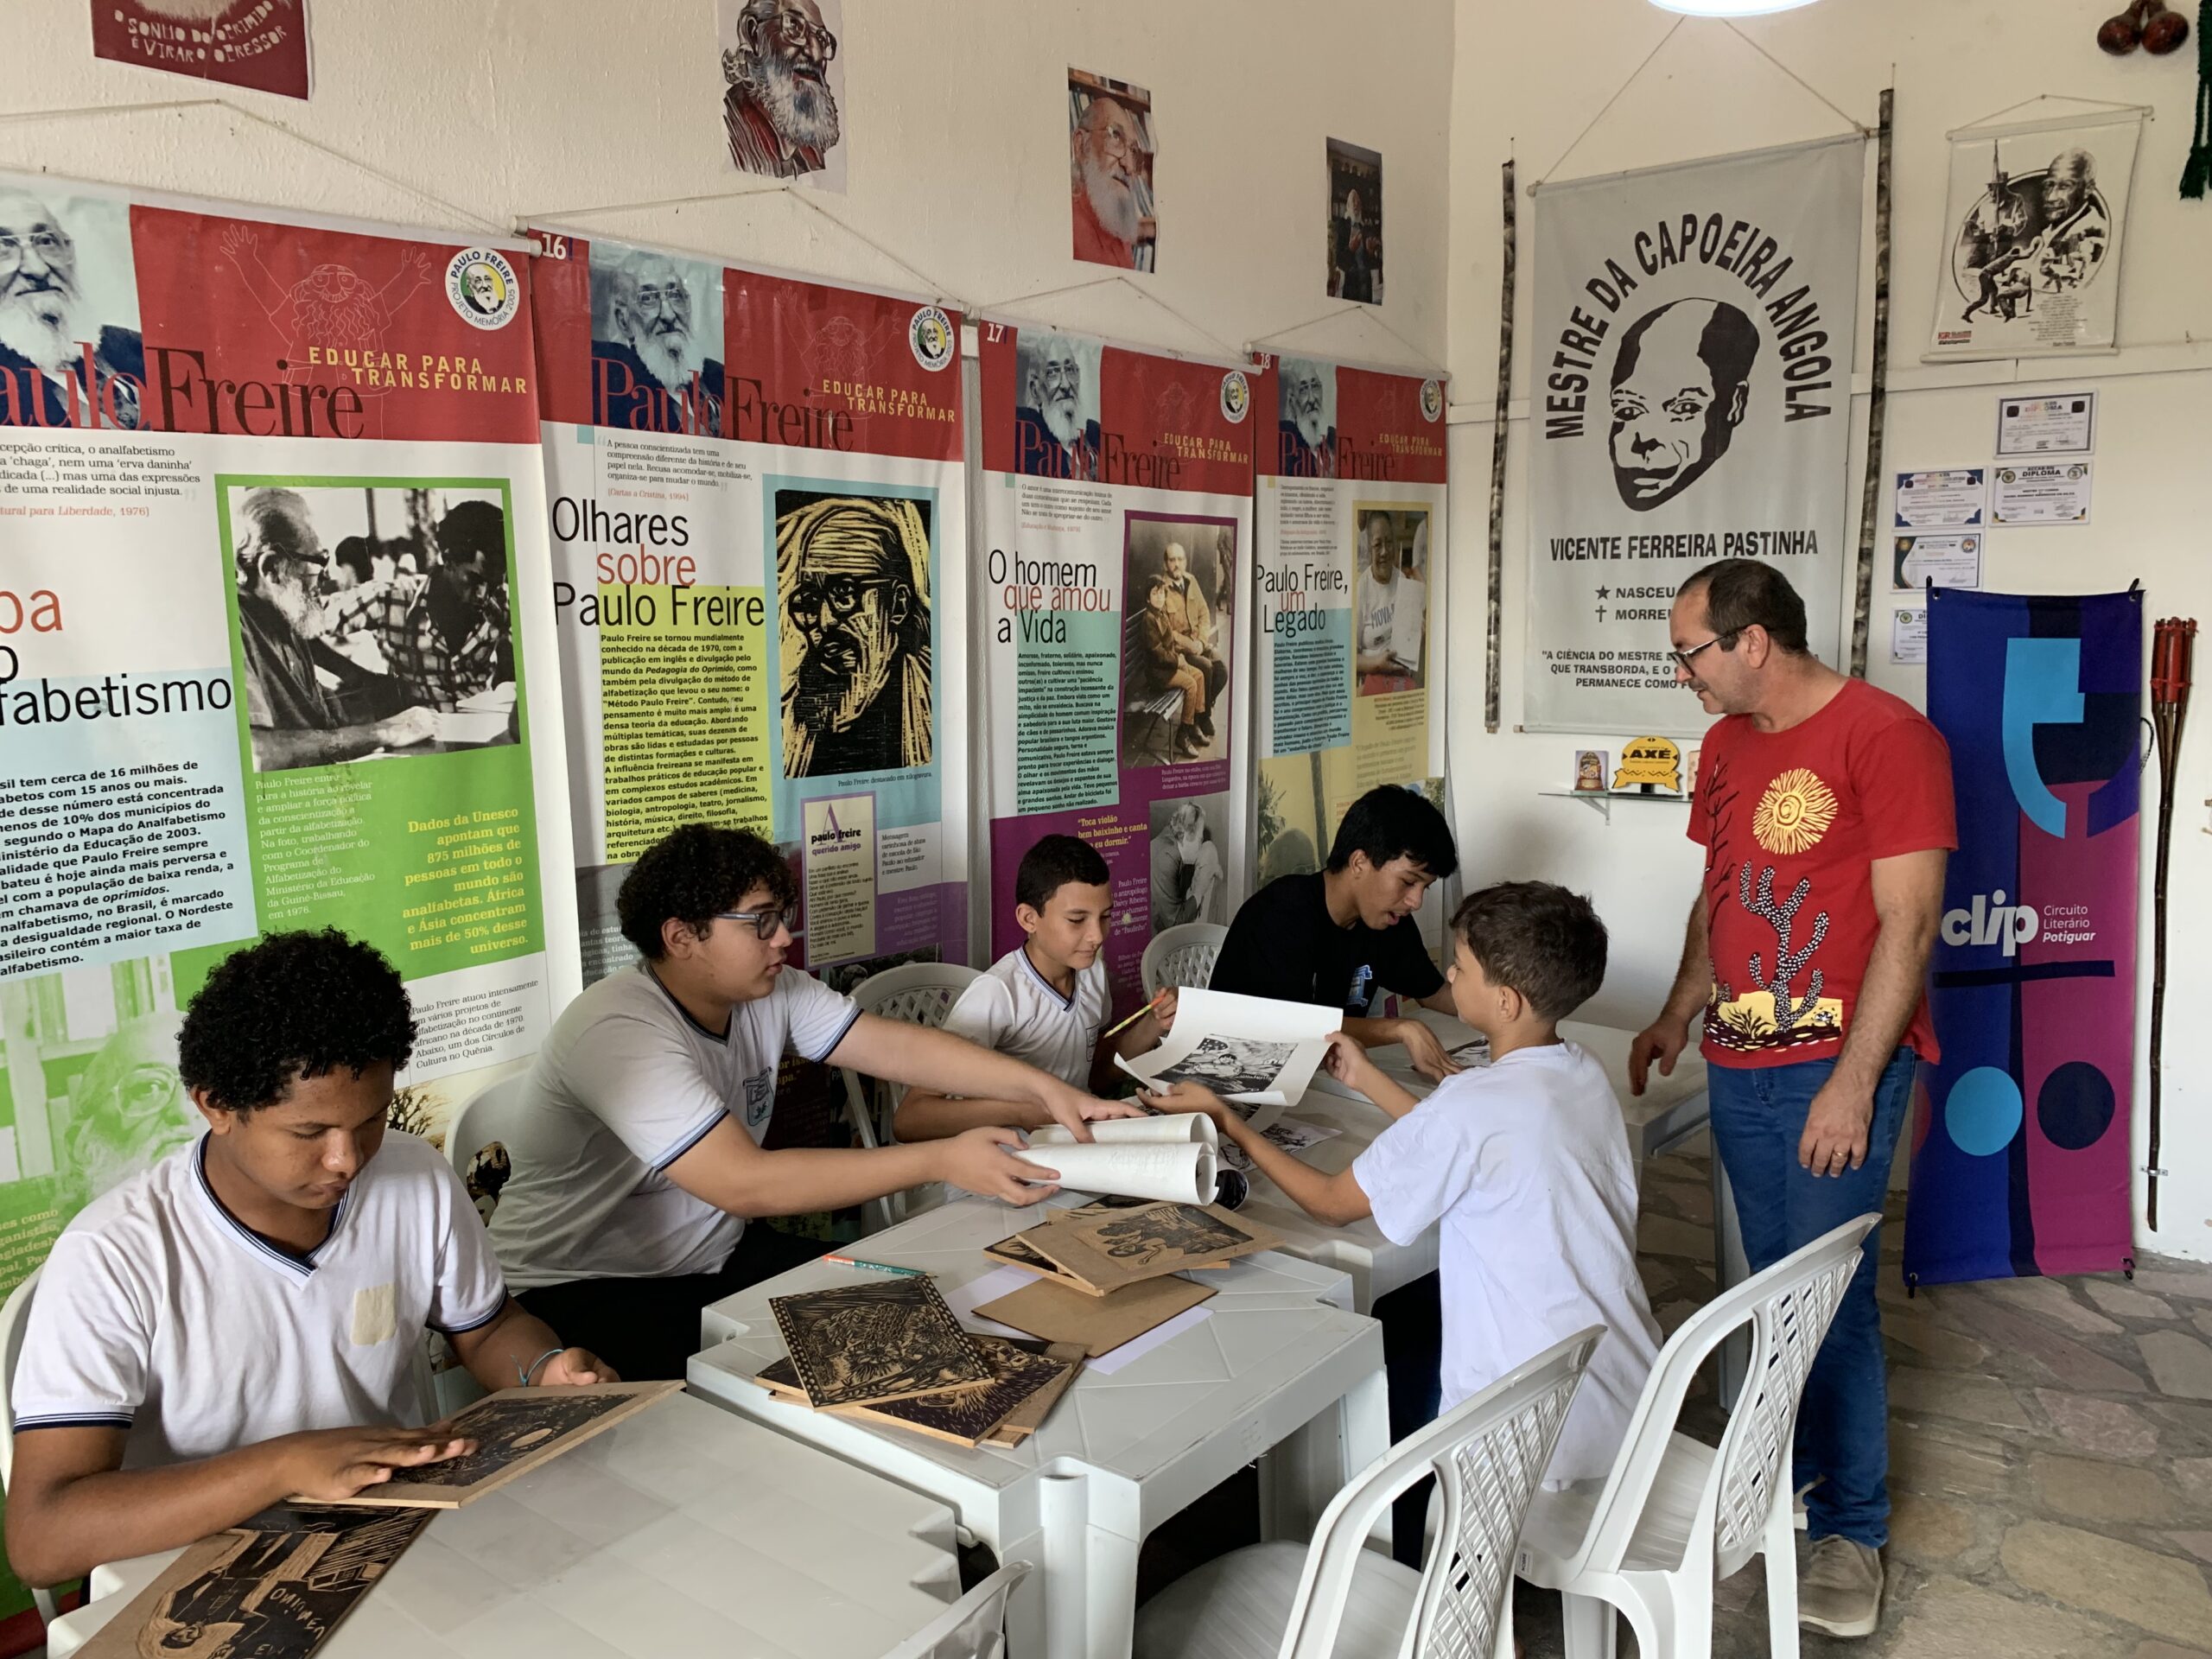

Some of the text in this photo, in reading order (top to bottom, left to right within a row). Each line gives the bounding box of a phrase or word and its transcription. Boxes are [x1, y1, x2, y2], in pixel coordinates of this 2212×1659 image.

[115, 10, 124, 22] O
[128, 17, 186, 41] SONHO
[192, 29, 211, 43] DO
[542, 234, 567, 259] 16
[450, 251, 513, 284] PAULO FREIRE
[451, 283, 515, 326] PROJETO MEMÓRIA 2005
[912, 309, 951, 336] PAULO FREIRE
[987, 323, 1004, 343] 17
[1546, 213, 1832, 440] MESTRE DA CAPOEIRA ANGOLA
[308, 346, 483, 375] EDUCAR PARA
[1261, 353, 1272, 370] 18
[145, 346, 364, 440] Freire
[352, 367, 527, 394] TRANSFORMAR
[823, 379, 927, 406] EDUCAR PARA
[592, 357, 853, 451] Paulo Freire
[848, 397, 955, 423] TRANSFORMAR
[44, 442, 85, 455] crítica,
[87, 446, 96, 454] o
[98, 444, 175, 456] analfabetismo
[613, 441, 639, 449] pessoa
[639, 442, 691, 454] conscientizada
[691, 447, 706, 455] tem
[1165, 433, 1231, 451] EDUCAR PARA
[1016, 420, 1181, 491] Paulo Freire
[1177, 446, 1249, 465] TRANSFORMAR
[3, 482, 19, 493] de
[51, 483, 106, 494] realidade
[108, 484, 142, 495] social
[143, 486, 183, 497] injusta.
[29, 507, 55, 518] para
[57, 505, 116, 518] Liberdade,
[552, 497, 690, 546] Olhares
[1550, 530, 1818, 561] VICENTE FERREIRA PASTINHA
[597, 543, 696, 587] sobre
[988, 549, 1096, 588] O homem
[1257, 563, 1348, 594] Paulo Freire,
[553, 582, 765, 626] Paulo Freire
[1004, 585, 1110, 616] que amou
[1281, 591, 1305, 612] um
[1616, 587, 1675, 599] NASCEU
[998, 609, 1066, 643] a Vida
[1264, 602, 1325, 638] Legado
[600, 633, 625, 642] Paulo
[626, 633, 652, 642] Freire
[664, 633, 691, 642] tornou
[693, 632, 745, 641] mundialmente
[600, 644, 644, 653] conhecido
[657, 644, 687, 652] década
[687, 644, 699, 652] de
[700, 644, 721, 652] 1970,
[1542, 648, 1662, 661] "A CIÊNCIA DO MESTRE
[1551, 664, 1671, 676] QUE TRANSBORDA, E O
[1576, 678, 1677, 689] PERMANECE COMO
[1630, 747, 1671, 759] AXÉ
[18, 777, 47, 787] tem
[50, 772, 86, 784] cerca
[89, 769, 106, 780] de
[109, 766, 126, 778] 16
[129, 762, 179, 776] milhões
[181, 760, 198, 770] de
[48, 788, 76, 798] com
[80, 784, 97, 795] 15
[99, 782, 130, 792] anos
[133, 779, 150, 789] ou
[153, 774, 188, 786] mais.
[18, 804, 59, 816] desse
[62, 798, 113, 811] número
[116, 791, 143, 804] está
[146, 784, 224, 801] concentrada
[407, 808, 518, 833] Dados da Unesco
[1078, 830, 1092, 839] bem
[1094, 826, 1123, 837] baixinho
[1128, 823, 1147, 832] canta
[1098, 815, 1118, 824] violão
[435, 823, 520, 847] apontam que
[811, 828, 861, 844] paulo freire
[426, 838, 521, 863] 875 milhões de
[811, 842, 861, 856] querido amigo
[402, 887, 525, 918] analfabetas. África
[2044, 905, 2088, 916] Circuito
[1941, 888, 2039, 957] clip
[2044, 918, 2091, 930] Literário
[2043, 931, 2096, 944] Potiguar
[415, 1055, 448, 1069] Cultura
[461, 1045, 494, 1058] Quênia.
